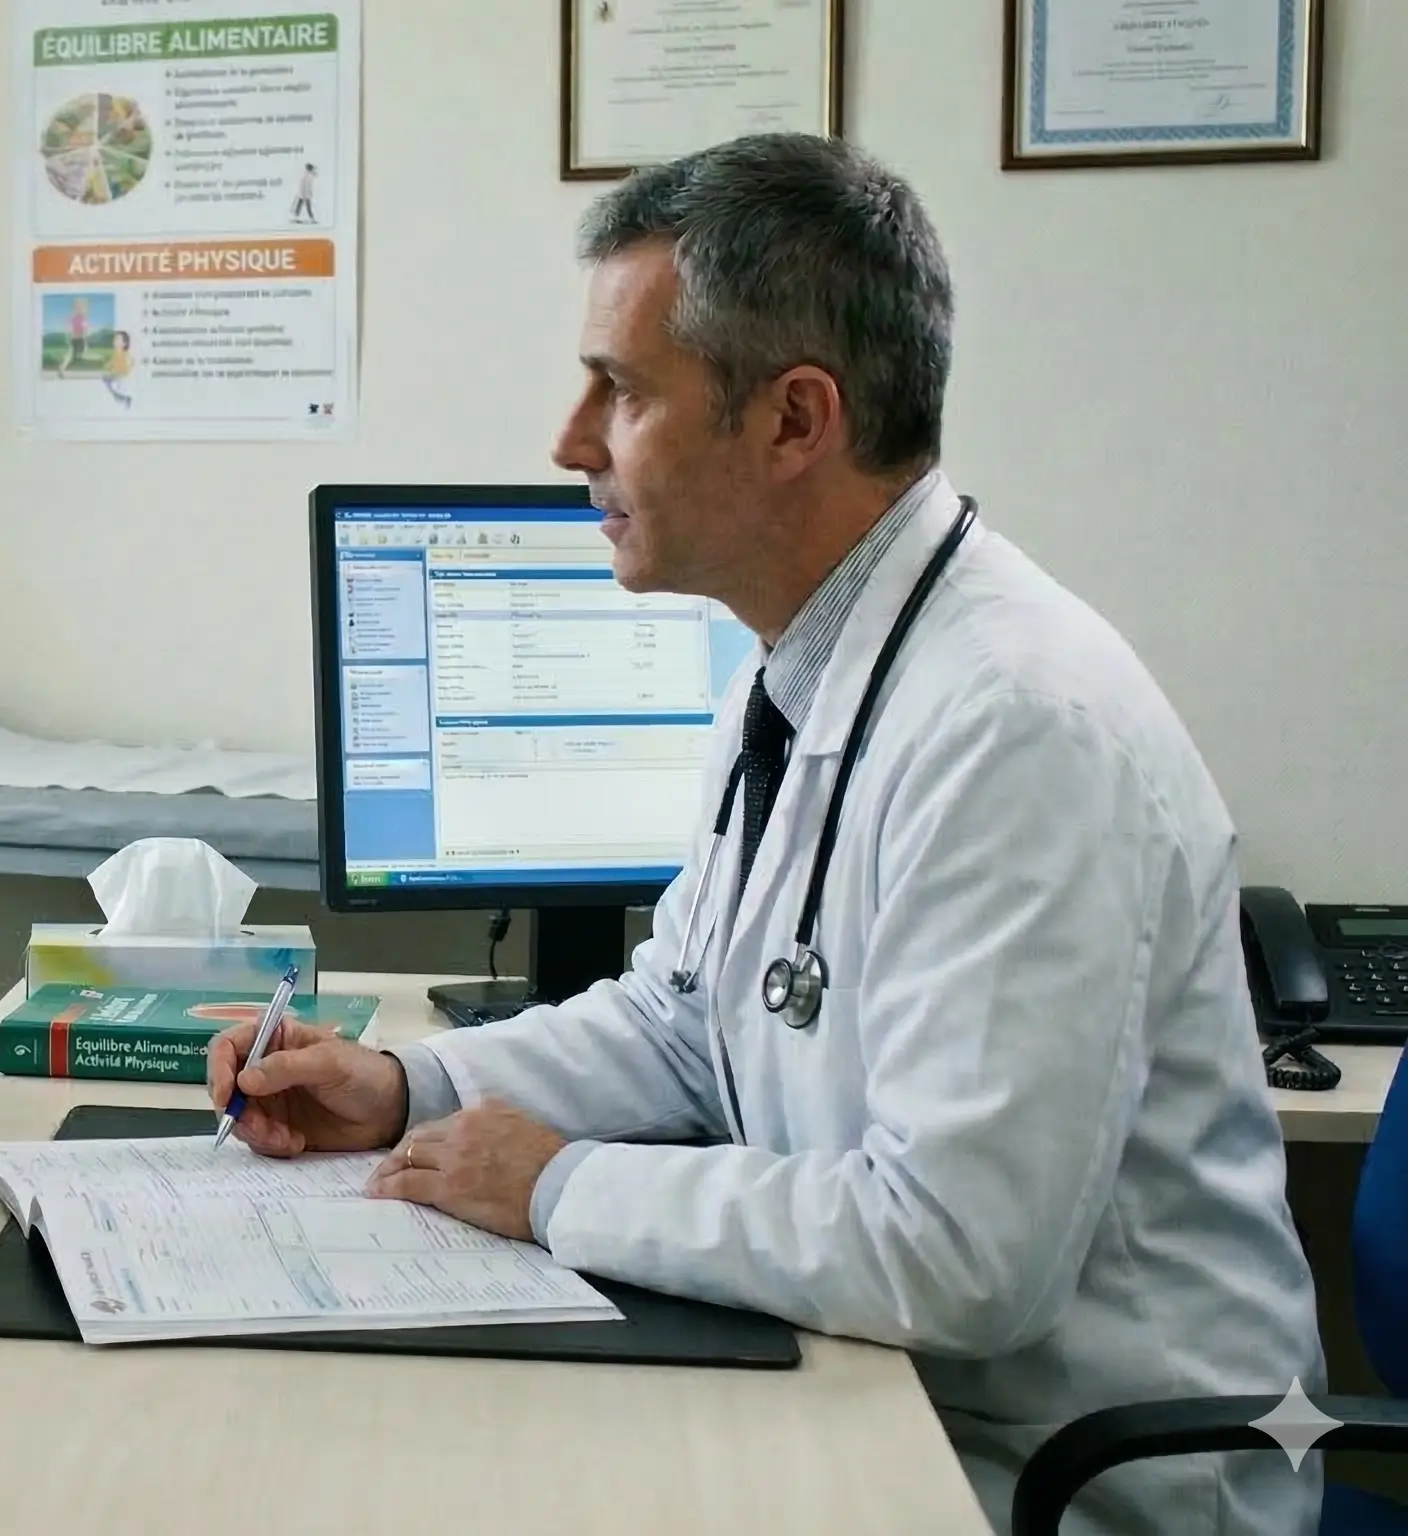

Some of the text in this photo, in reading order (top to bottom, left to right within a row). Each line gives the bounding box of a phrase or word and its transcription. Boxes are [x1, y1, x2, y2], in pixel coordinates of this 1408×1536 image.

[42, 21, 329, 59] ÉQUILIBRE ALIMENTAIRE
[68, 247, 296, 274] ACTIVITÉ PHYSIQUE
[124, 1055, 180, 1073] Physique
